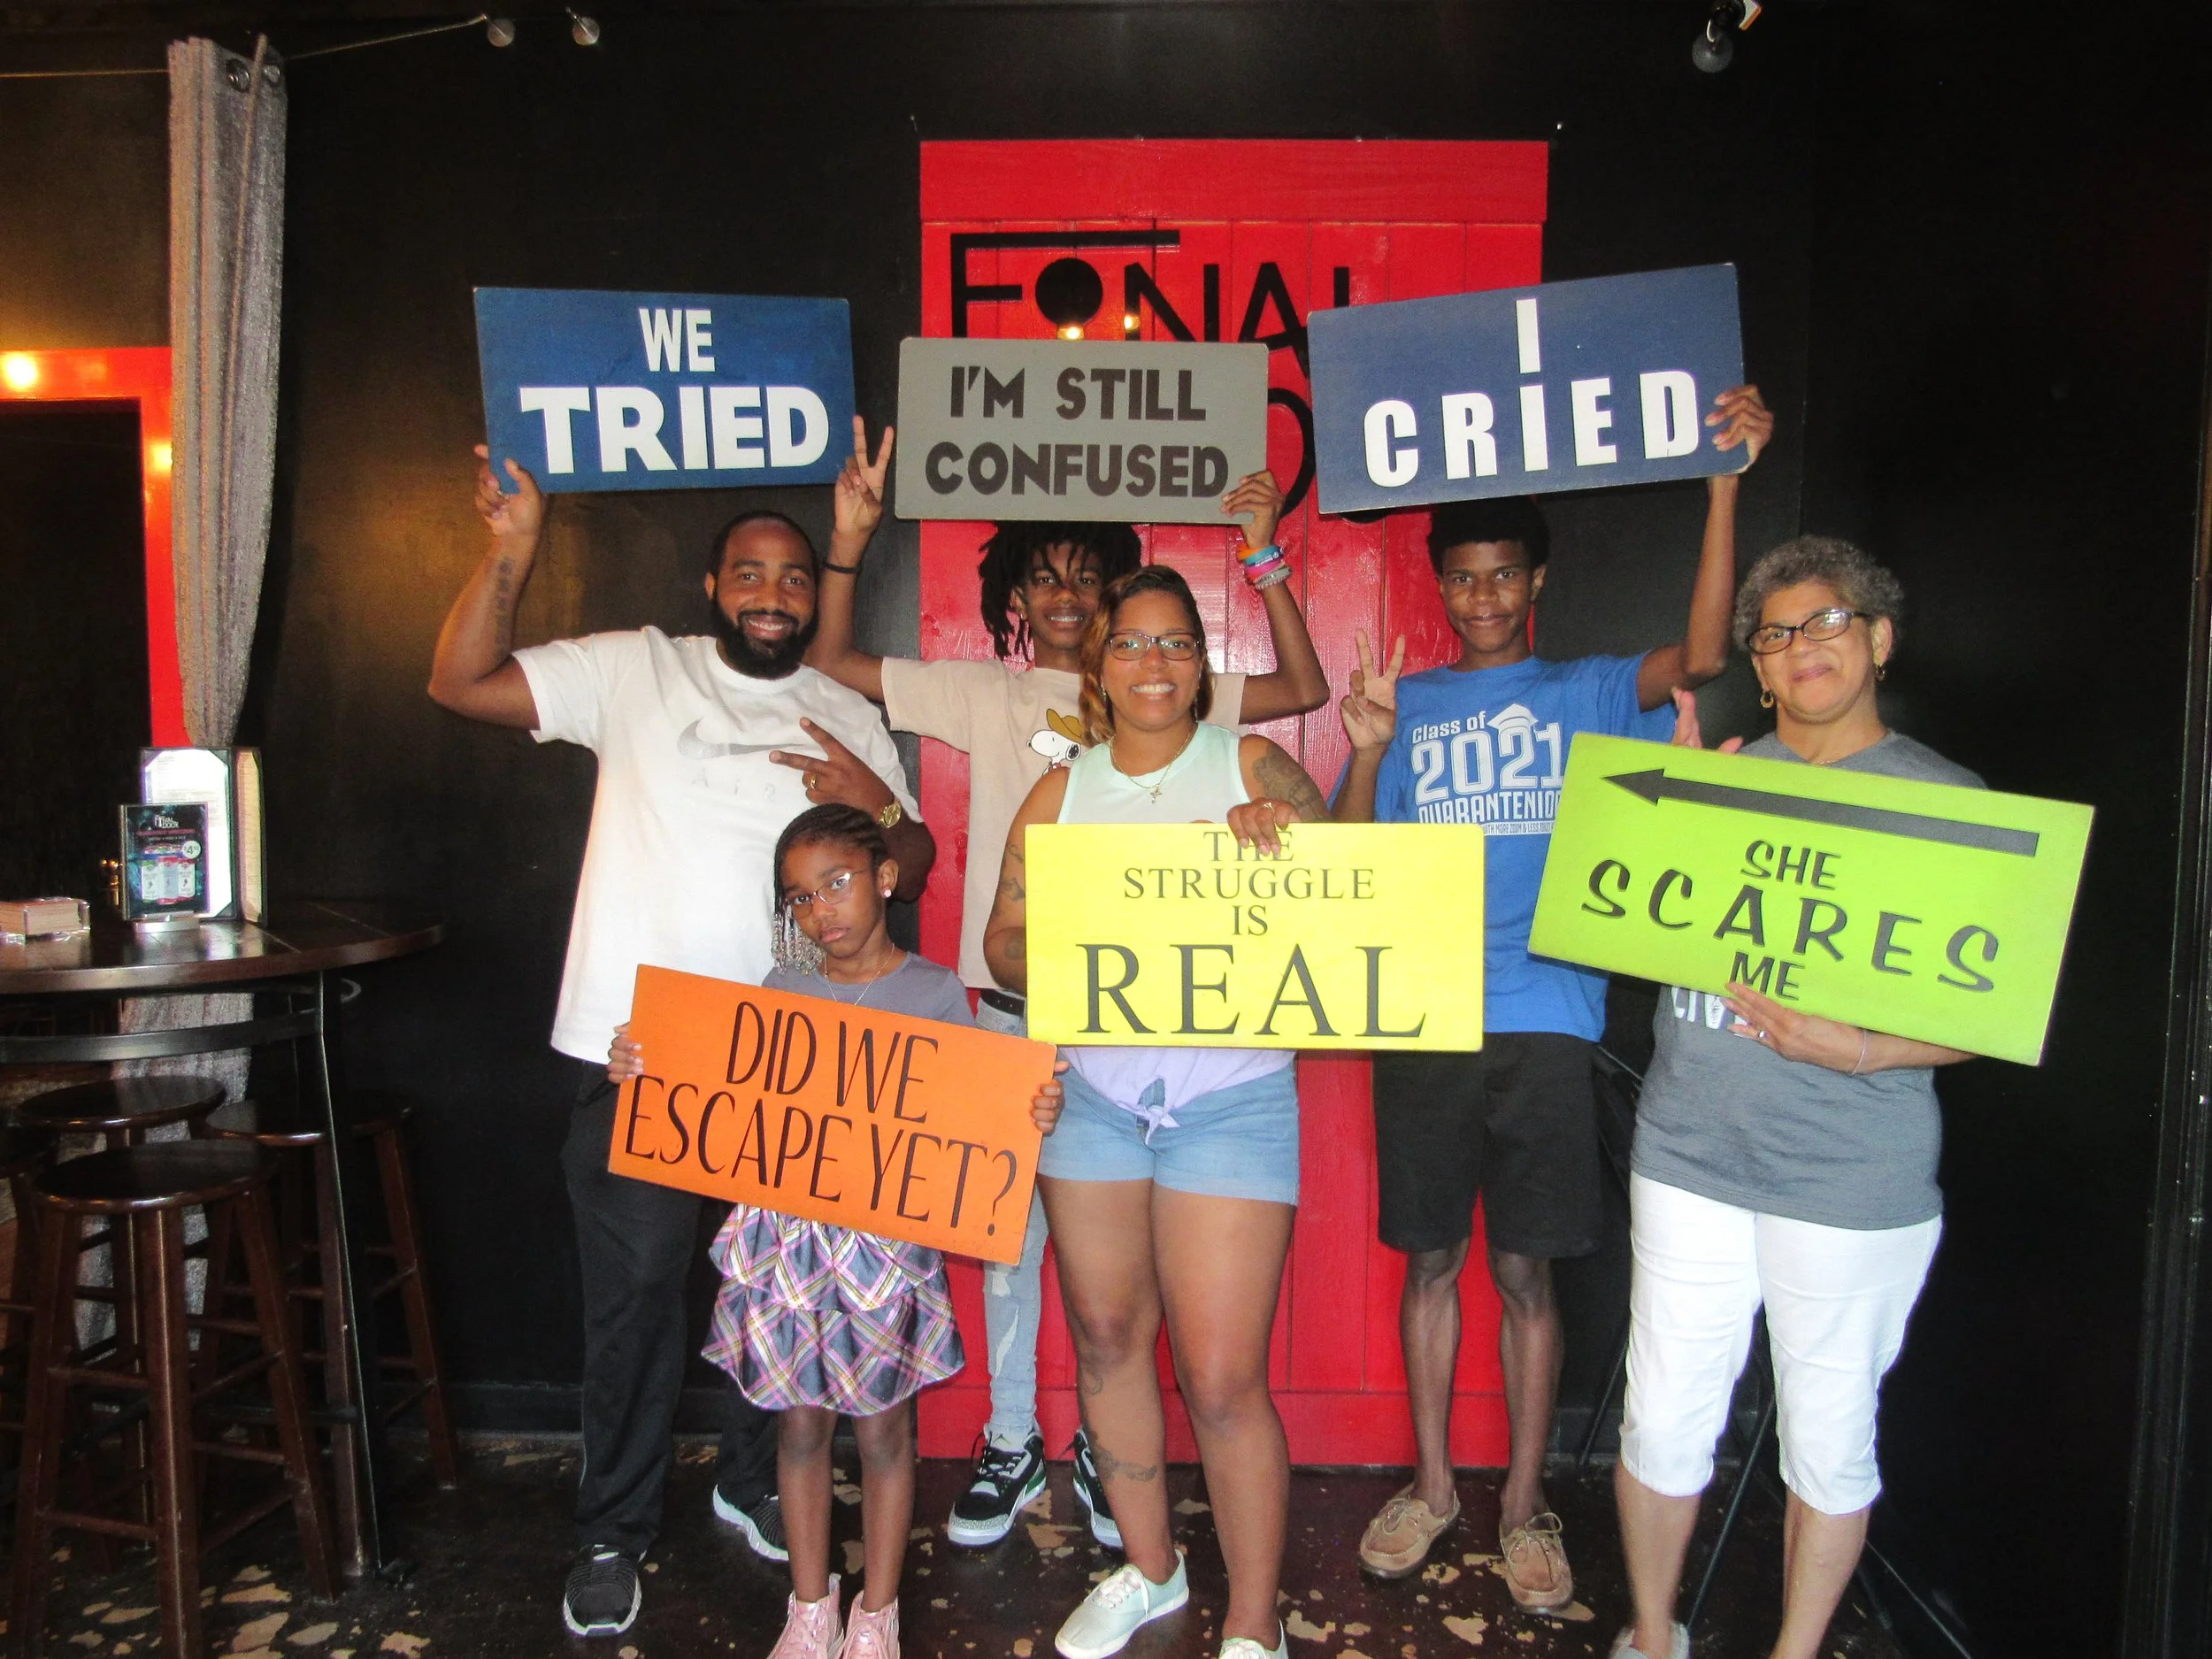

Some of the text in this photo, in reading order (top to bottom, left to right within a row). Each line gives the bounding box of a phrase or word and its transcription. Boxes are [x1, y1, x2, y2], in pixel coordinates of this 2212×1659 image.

[639, 308, 716, 372] WE
[1516, 298, 1540, 373] I
[950, 365, 1206, 421] I'M STILL
[519, 386, 829, 474] TRIED
[1363, 371, 1699, 488] CRIED
[926, 441, 1229, 497] CONFUSED
[1412, 710, 1486, 744] Class of
[1410, 722, 1563, 805] 2021
[1528, 822, 1539, 833] LESS
[1124, 868, 1375, 900] STRUGGLE
[1740, 840, 1841, 890] SHE
[1231, 905, 1269, 937] IS
[1581, 859, 2000, 992] SCARES
[1076, 943, 1426, 1038] REAL
[1729, 951, 1807, 1001] ME
[726, 1001, 939, 1123] DID WE
[625, 1074, 1018, 1236] ESCAPE YET?
